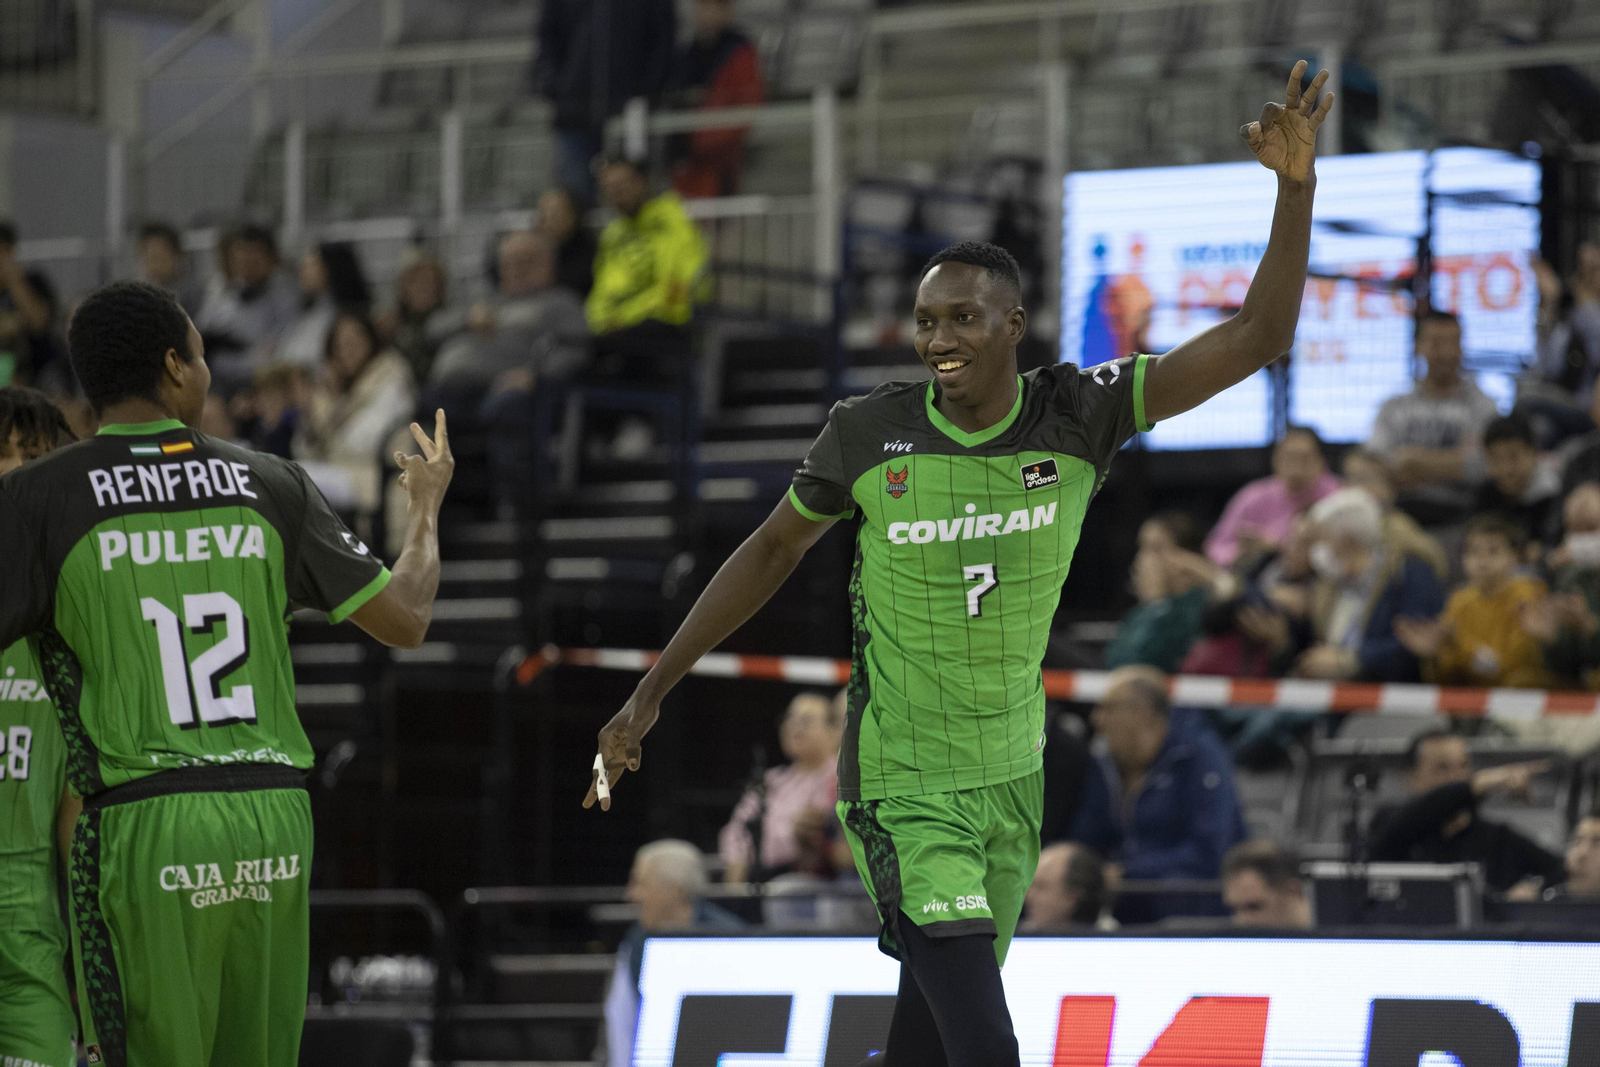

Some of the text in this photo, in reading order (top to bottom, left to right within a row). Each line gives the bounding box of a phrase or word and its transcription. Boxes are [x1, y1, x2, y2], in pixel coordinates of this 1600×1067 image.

[88, 459, 258, 507] RENFROE
[1025, 472, 1040, 481] liga
[1027, 474, 1057, 488] endesa
[98, 524, 267, 571] PULEVA
[963, 562, 1000, 618] 7
[139, 591, 258, 730] 12
[0, 725, 33, 780] 8
[159, 862, 225, 891] CAJA
[190, 884, 272, 909] GRANAD
